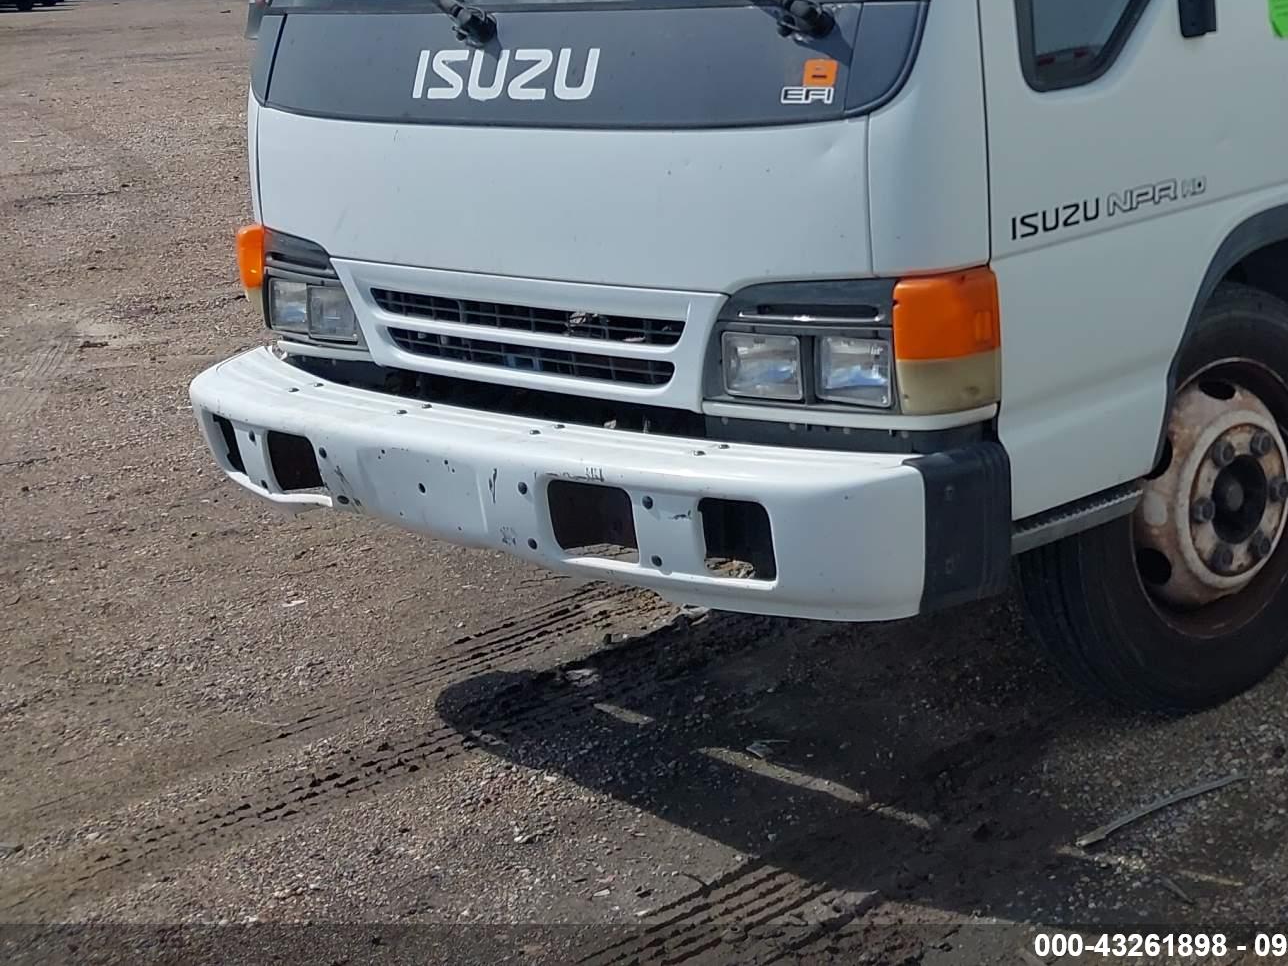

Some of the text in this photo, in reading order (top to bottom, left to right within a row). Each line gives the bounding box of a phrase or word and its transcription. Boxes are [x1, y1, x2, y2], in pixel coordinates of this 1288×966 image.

[412, 48, 600, 100] ISUZU
[780, 86, 834, 104] EFI
[1011, 197, 1100, 240] ISUZU
[1107, 178, 1178, 216] NPR
